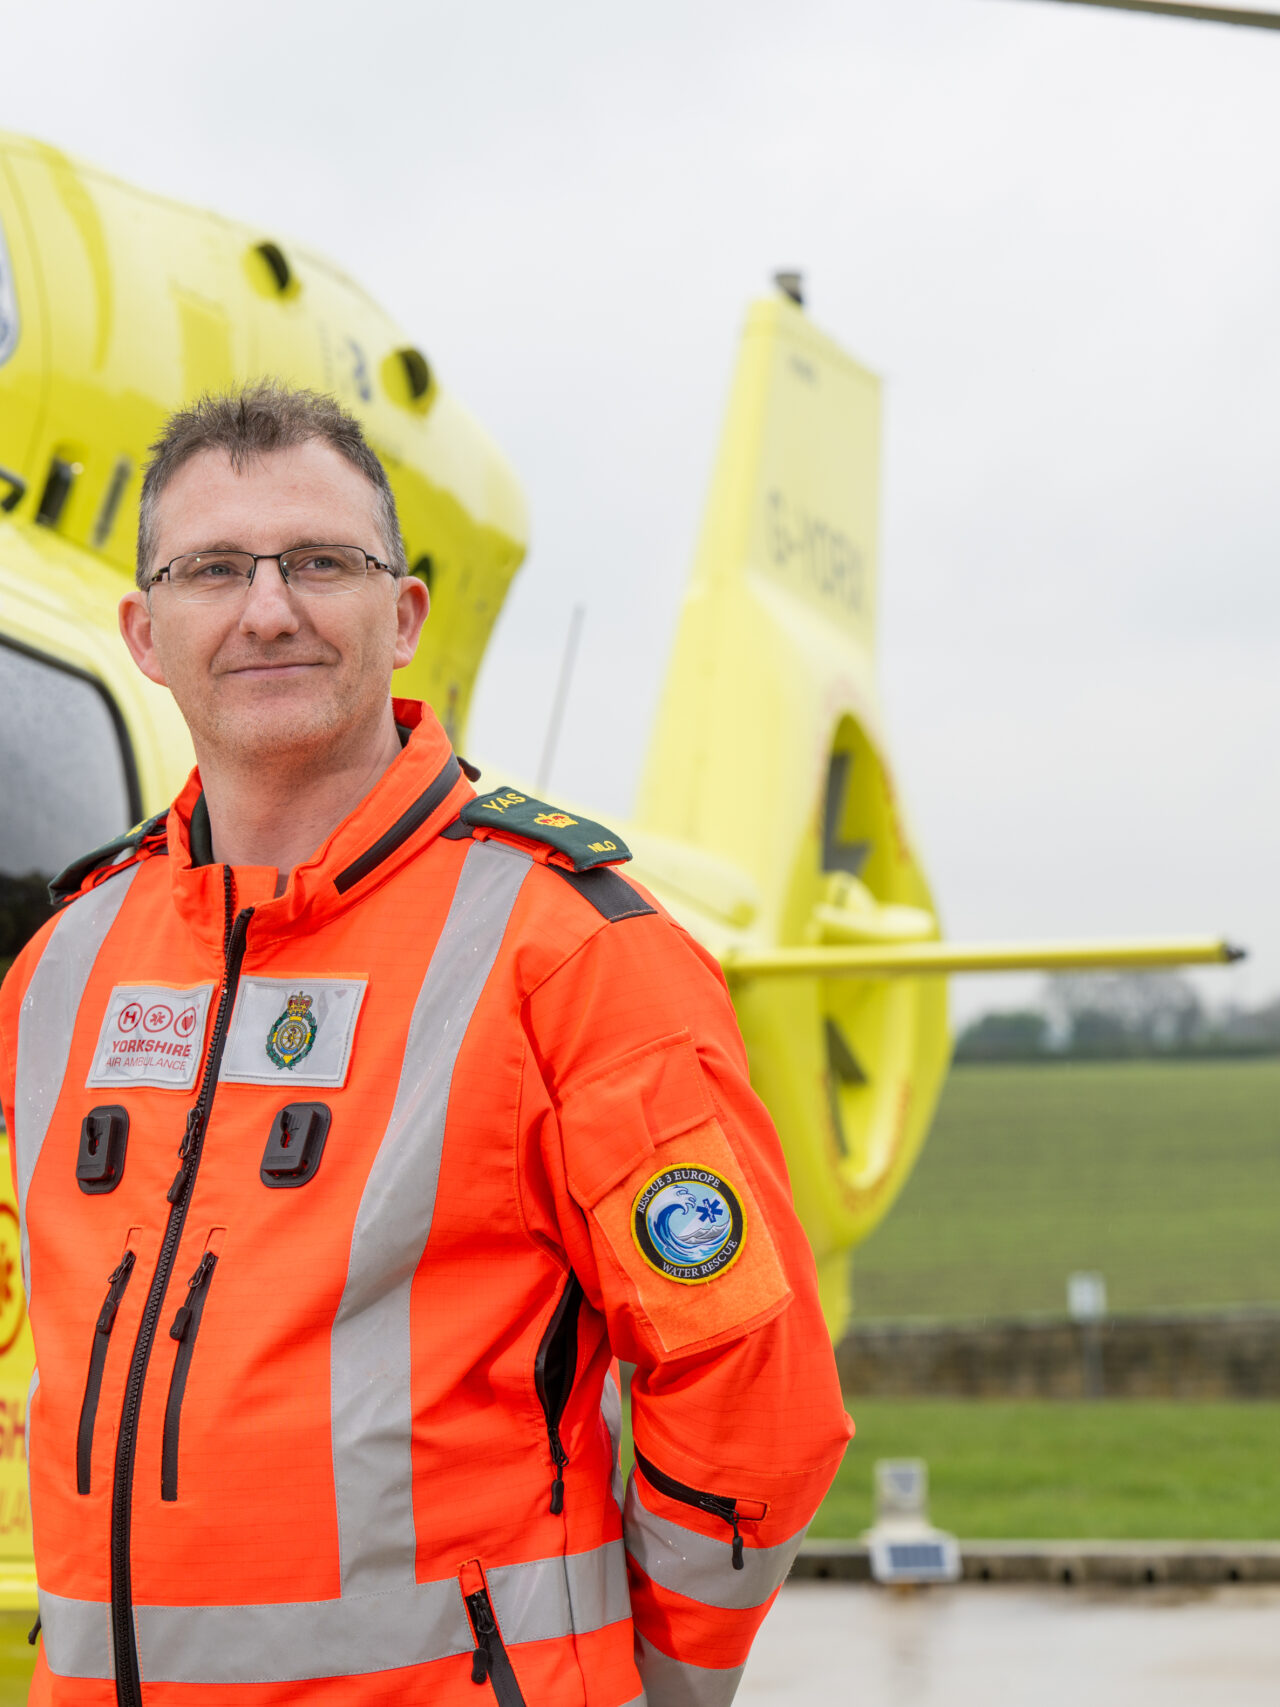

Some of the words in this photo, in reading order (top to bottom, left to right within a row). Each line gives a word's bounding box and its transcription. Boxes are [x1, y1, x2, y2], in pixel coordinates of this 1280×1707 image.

[482, 793, 526, 814] YAS
[112, 1040, 192, 1057] YORKSHIRE
[106, 1057, 122, 1067] AIR
[123, 1057, 186, 1071] AMBULANCE
[637, 1178, 665, 1213] RESCUE
[665, 1174, 672, 1183] 3
[674, 1170, 720, 1188] EUROPE
[662, 1262, 699, 1278] WATER
[701, 1240, 738, 1274] RESCUE
